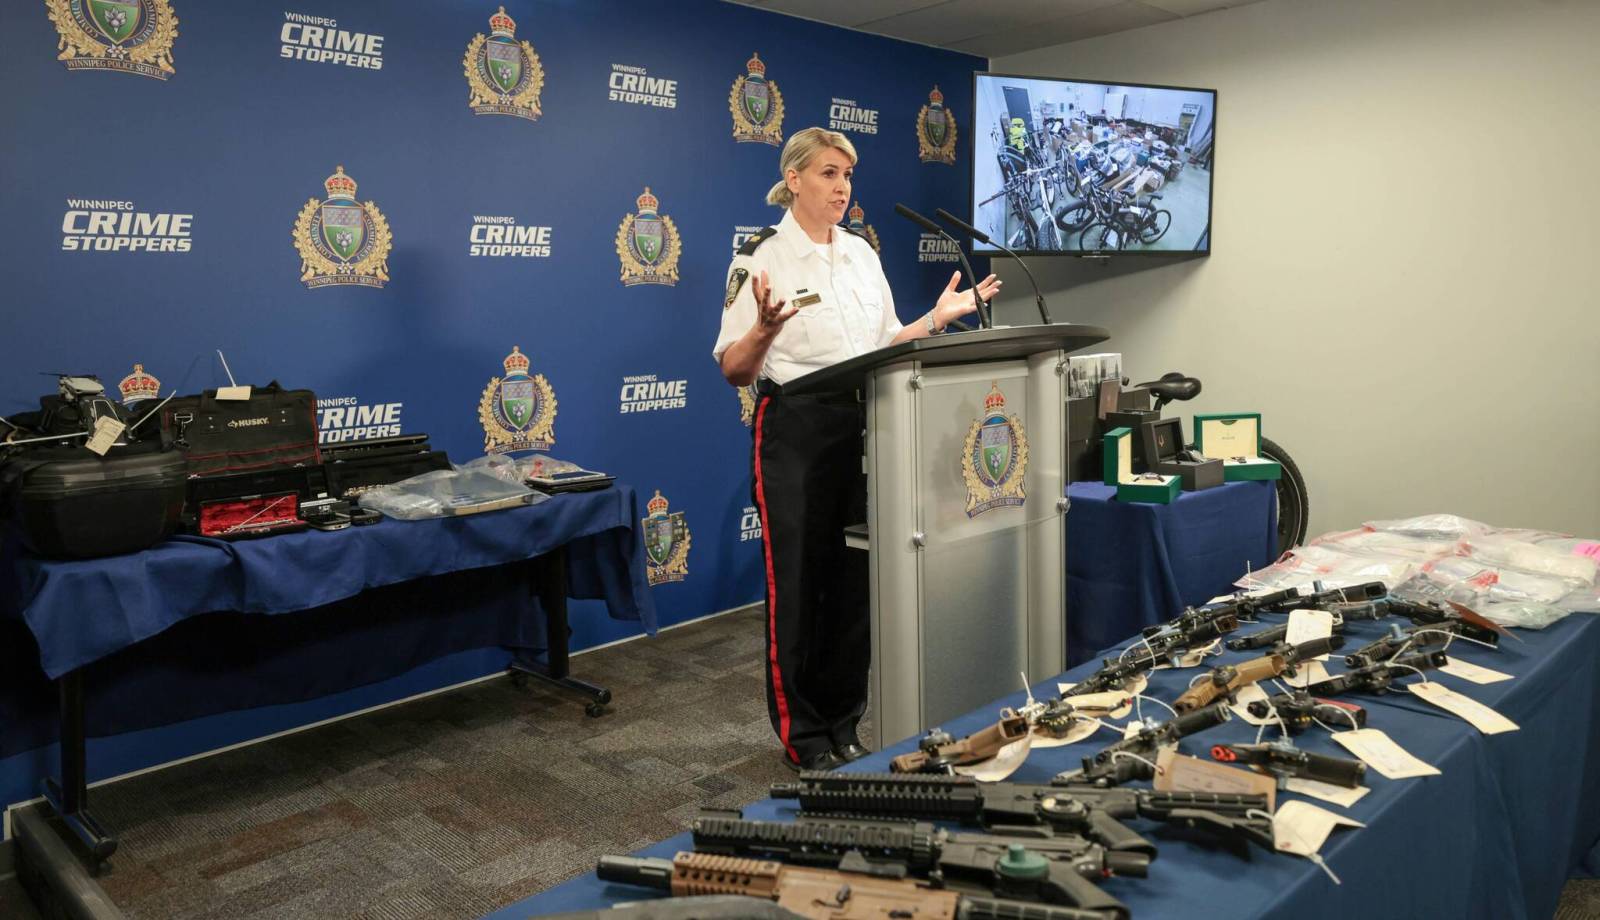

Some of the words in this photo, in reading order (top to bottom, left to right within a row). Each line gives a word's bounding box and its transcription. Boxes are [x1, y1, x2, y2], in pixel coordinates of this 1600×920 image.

[284, 11, 337, 28] WINNIPEG
[280, 22, 384, 56] CRIME
[280, 44, 383, 70] STOPPERS
[67, 59, 106, 69] WINNIPEG
[107, 61, 134, 70] POLICE
[135, 64, 167, 78] SERVICE
[611, 63, 647, 75] WINNIPEG
[609, 71, 678, 97] CRIME
[608, 89, 677, 109] STOPPERS
[830, 104, 879, 125] CRIME
[829, 119, 878, 135] STOPPERS
[66, 199, 134, 210] WINNIPEG
[62, 210, 193, 236] CRIME
[473, 215, 515, 225] WINNIPEG
[470, 224, 552, 245] CRIME
[61, 236, 193, 252] STOPPERS
[469, 244, 552, 257] STOPPERS
[918, 239, 960, 253] CRIME
[623, 374, 657, 384] WINNIPEG
[620, 380, 688, 402] CRIME
[317, 396, 358, 408] INNIPEG
[620, 397, 687, 414] STOPPERS
[238, 417, 268, 427] HUSKY
[317, 402, 403, 430] RIME
[318, 423, 402, 444] TOPPERS
